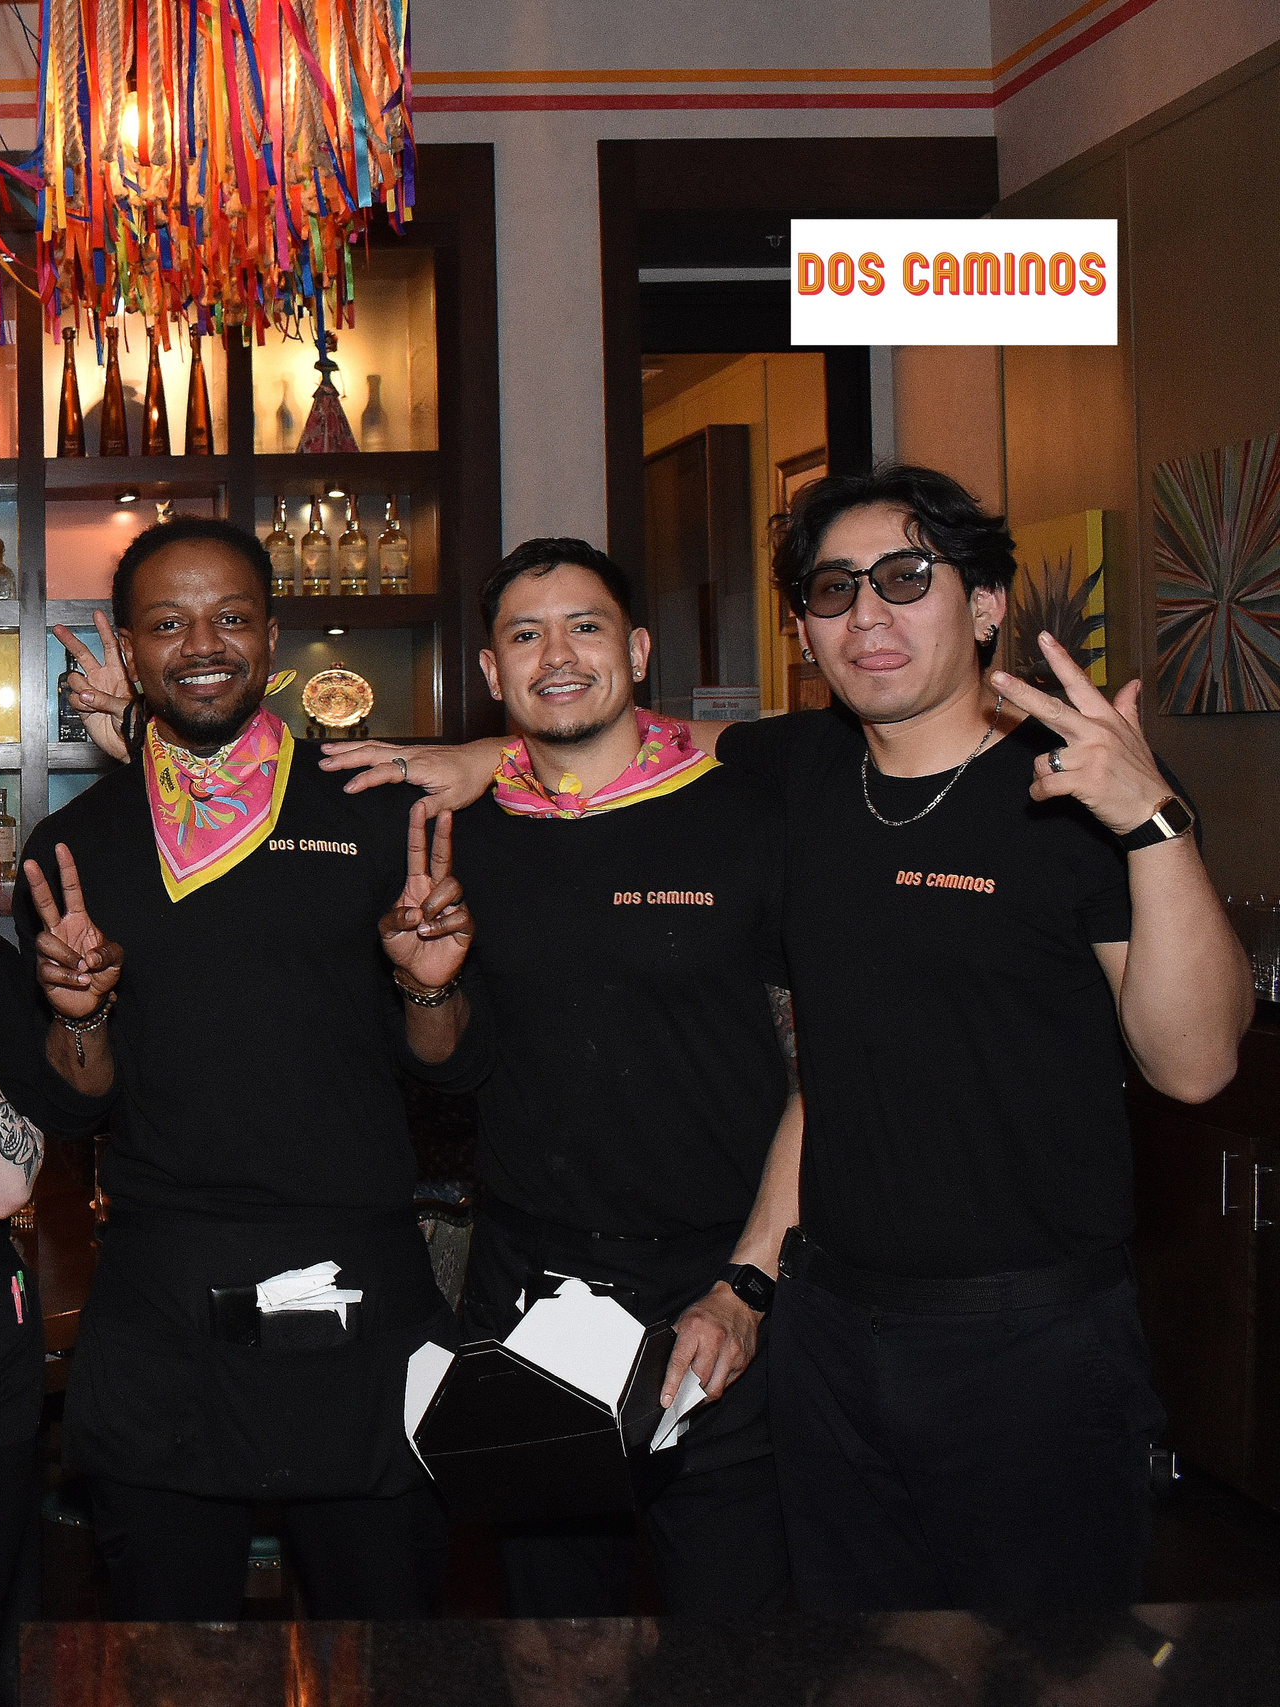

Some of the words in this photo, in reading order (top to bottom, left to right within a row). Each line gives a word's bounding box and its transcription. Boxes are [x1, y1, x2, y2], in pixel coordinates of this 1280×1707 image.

[269, 839, 296, 851] DOS
[299, 839, 358, 856] CAMINOS
[895, 870, 923, 886] DOS
[925, 872, 995, 894] CAMINOS
[613, 891, 642, 905] DOS
[646, 890, 714, 906] CAMINOS
